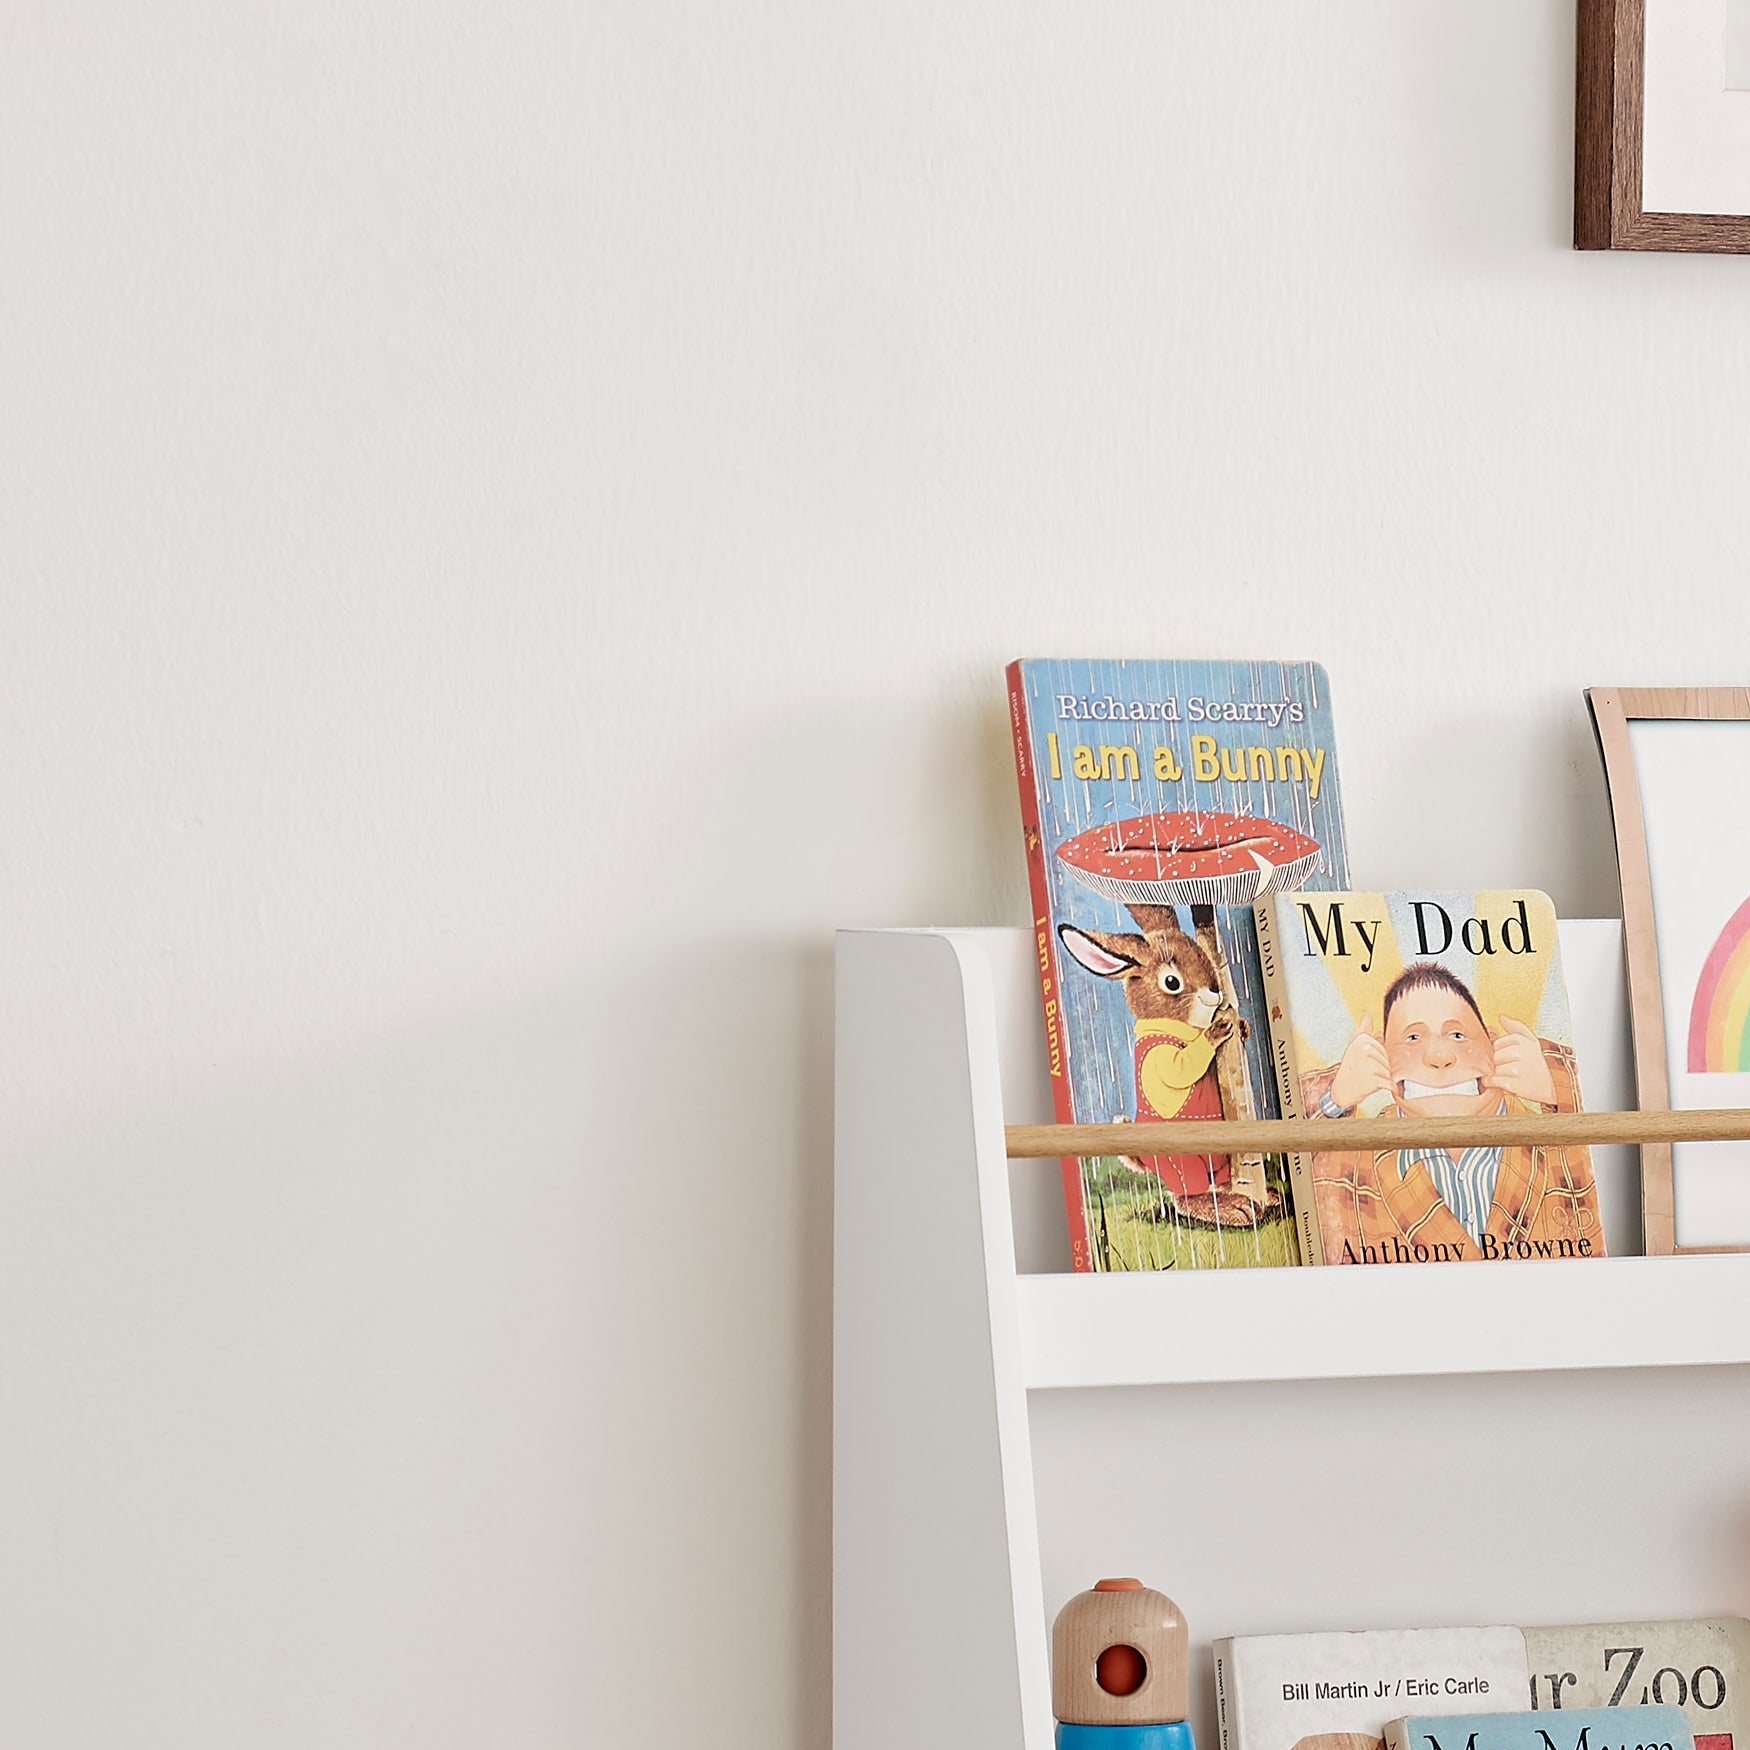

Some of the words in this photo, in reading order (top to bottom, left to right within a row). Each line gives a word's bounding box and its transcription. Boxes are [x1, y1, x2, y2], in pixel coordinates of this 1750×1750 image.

[1056, 694, 1181, 720] Richard
[1187, 696, 1304, 727] Scarry's
[1016, 736, 1026, 777] SCARRY
[1047, 732, 1061, 779] I
[1073, 743, 1141, 781] am
[1153, 745, 1183, 782] a
[1191, 734, 1325, 799] Bunny
[1036, 916, 1047, 926] I
[1258, 908, 1270, 934] MY
[1297, 902, 1382, 973] My
[1408, 900, 1537, 956] Dad
[1037, 932, 1049, 971] am
[1262, 940, 1275, 978] DAD
[1042, 978, 1052, 995] a
[1045, 999, 1061, 1077] Bunny
[1277, 1038, 1293, 1107] Anthony
[1340, 1236, 1465, 1265] Anthony
[1478, 1233, 1594, 1261] Browne
[1282, 1683, 1309, 1700] Bill
[1315, 1681, 1368, 1699] Martin
[1374, 1680, 1391, 1697] Jr
[1406, 1679, 1440, 1695] Eric
[1444, 1677, 1490, 1694] Carle
[1603, 1647, 1726, 1710] Zoo
